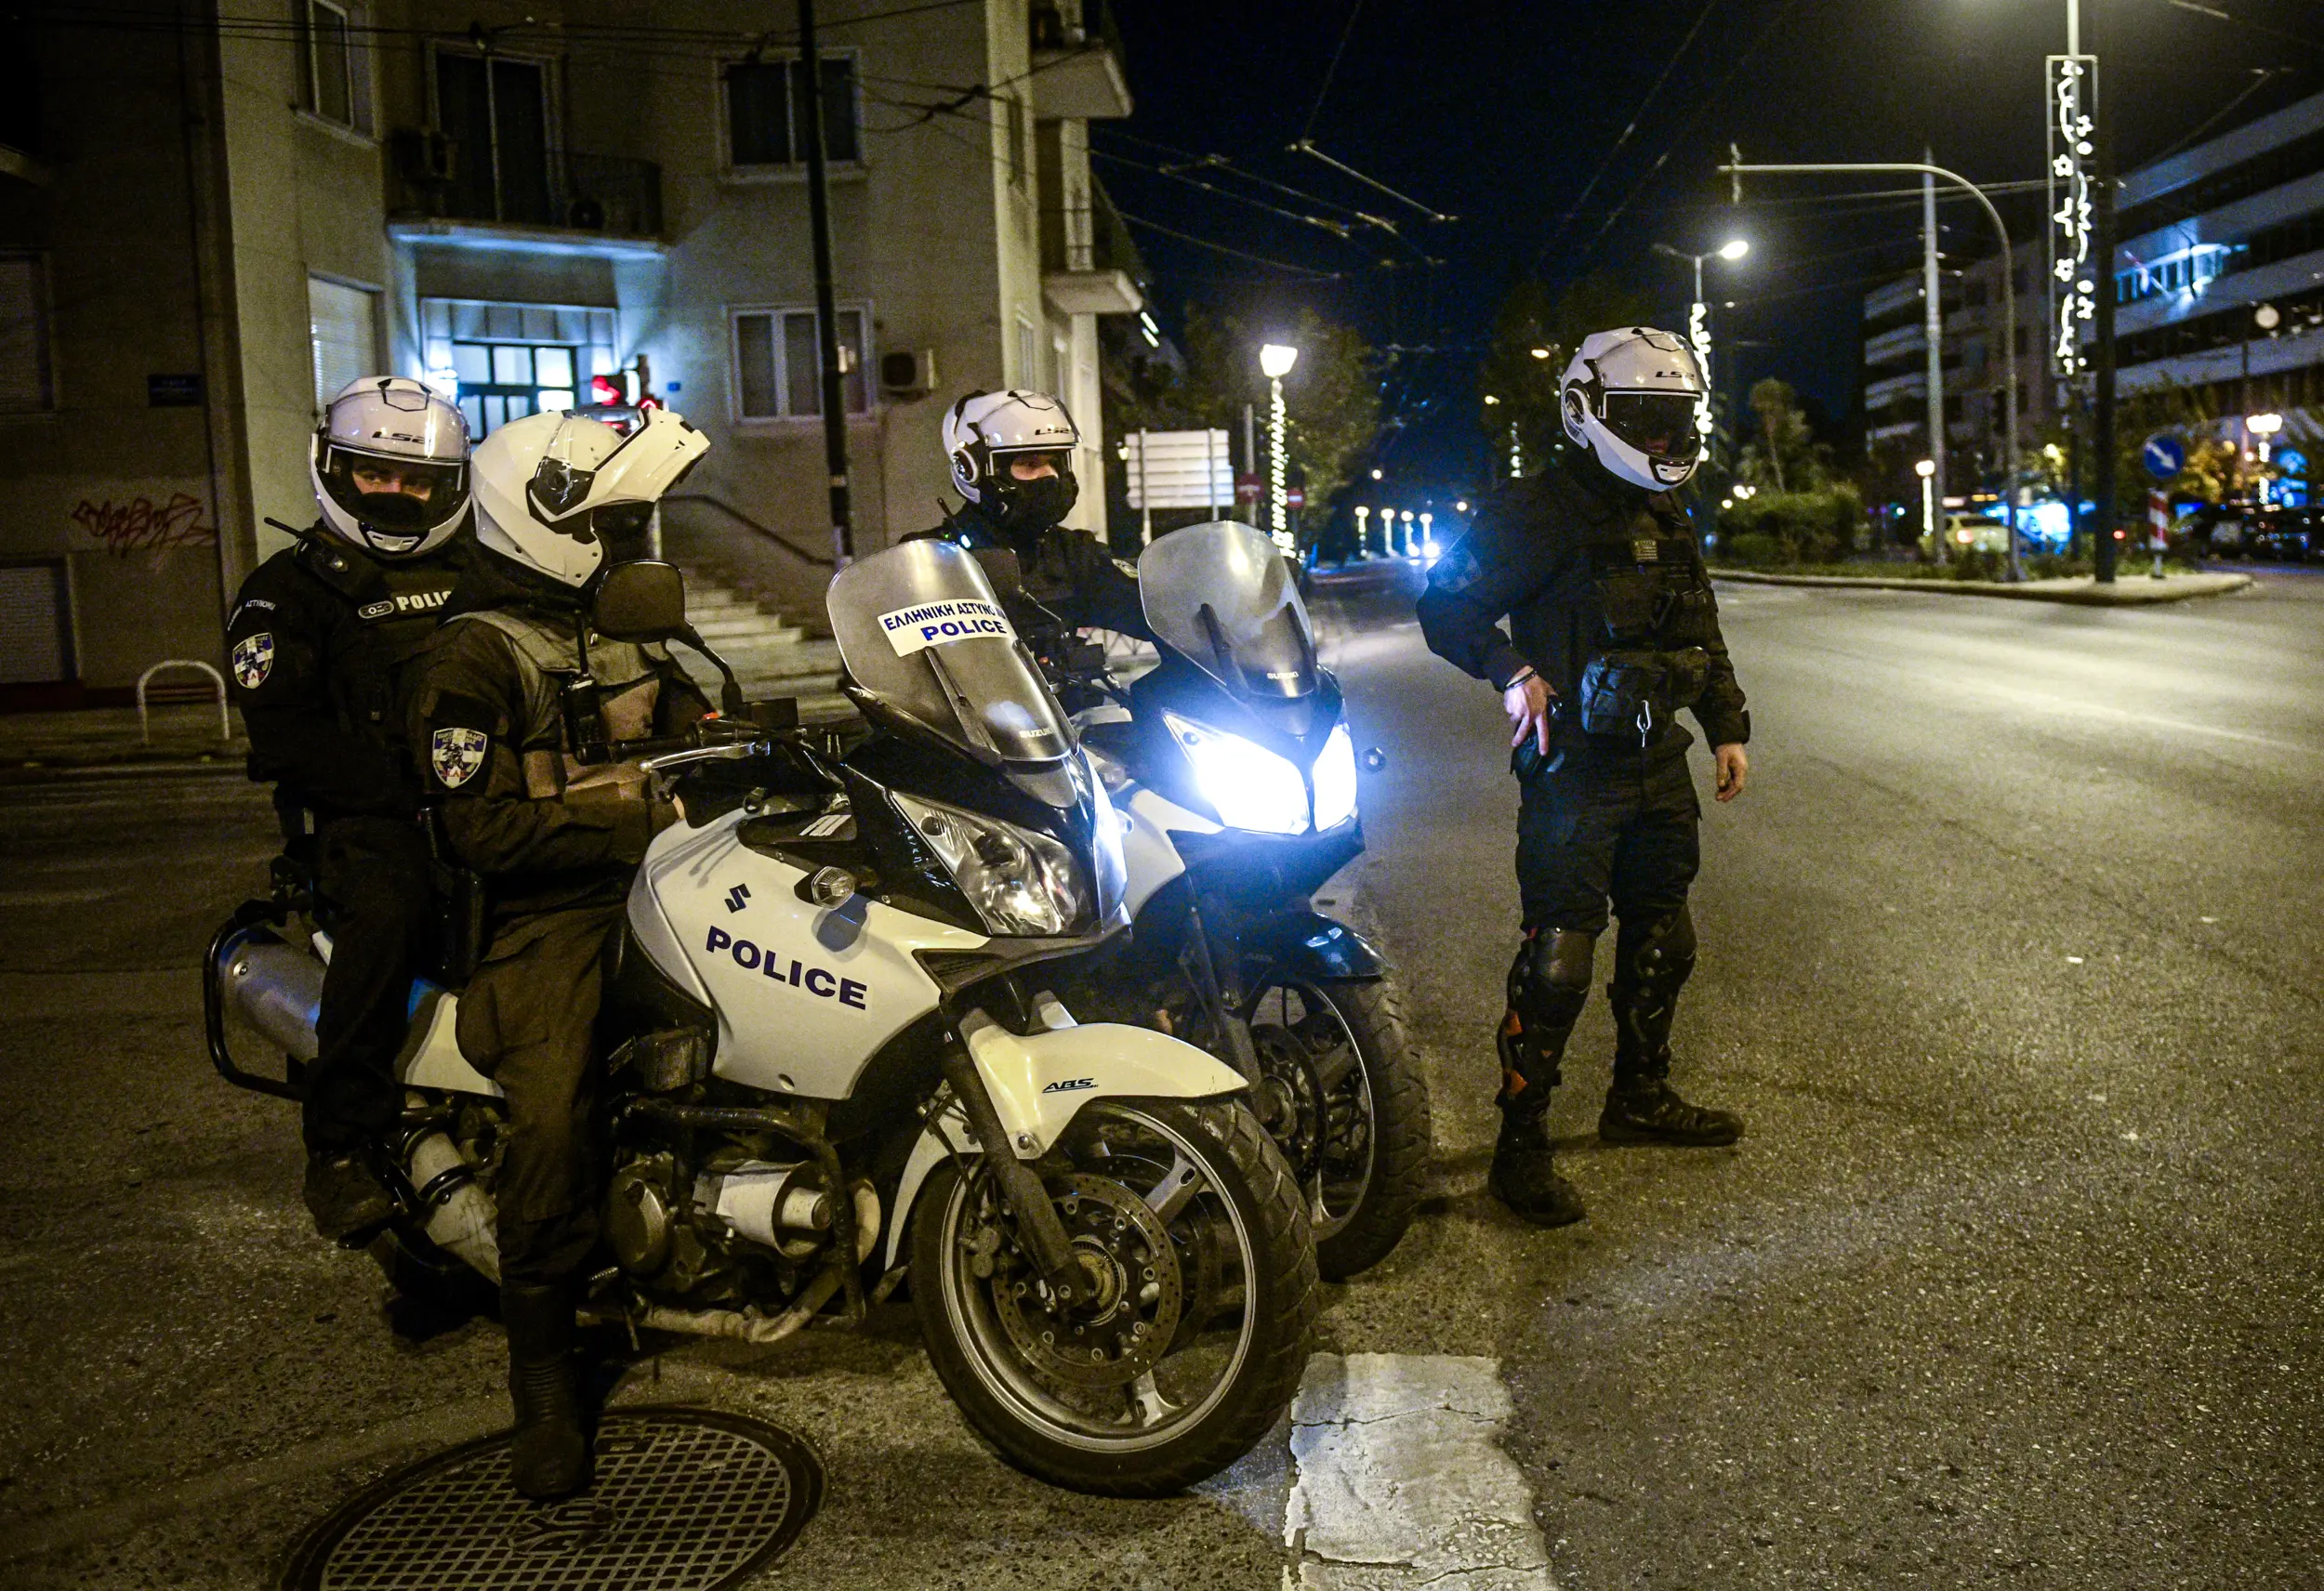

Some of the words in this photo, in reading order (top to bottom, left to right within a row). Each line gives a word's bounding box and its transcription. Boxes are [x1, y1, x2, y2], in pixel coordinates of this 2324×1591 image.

[883, 603, 956, 631] ΕΛΛΗΝΙΚΗ
[920, 619, 1008, 641] POLICE
[706, 925, 867, 1011] POLICE
[1042, 1077, 1095, 1093] ABS
